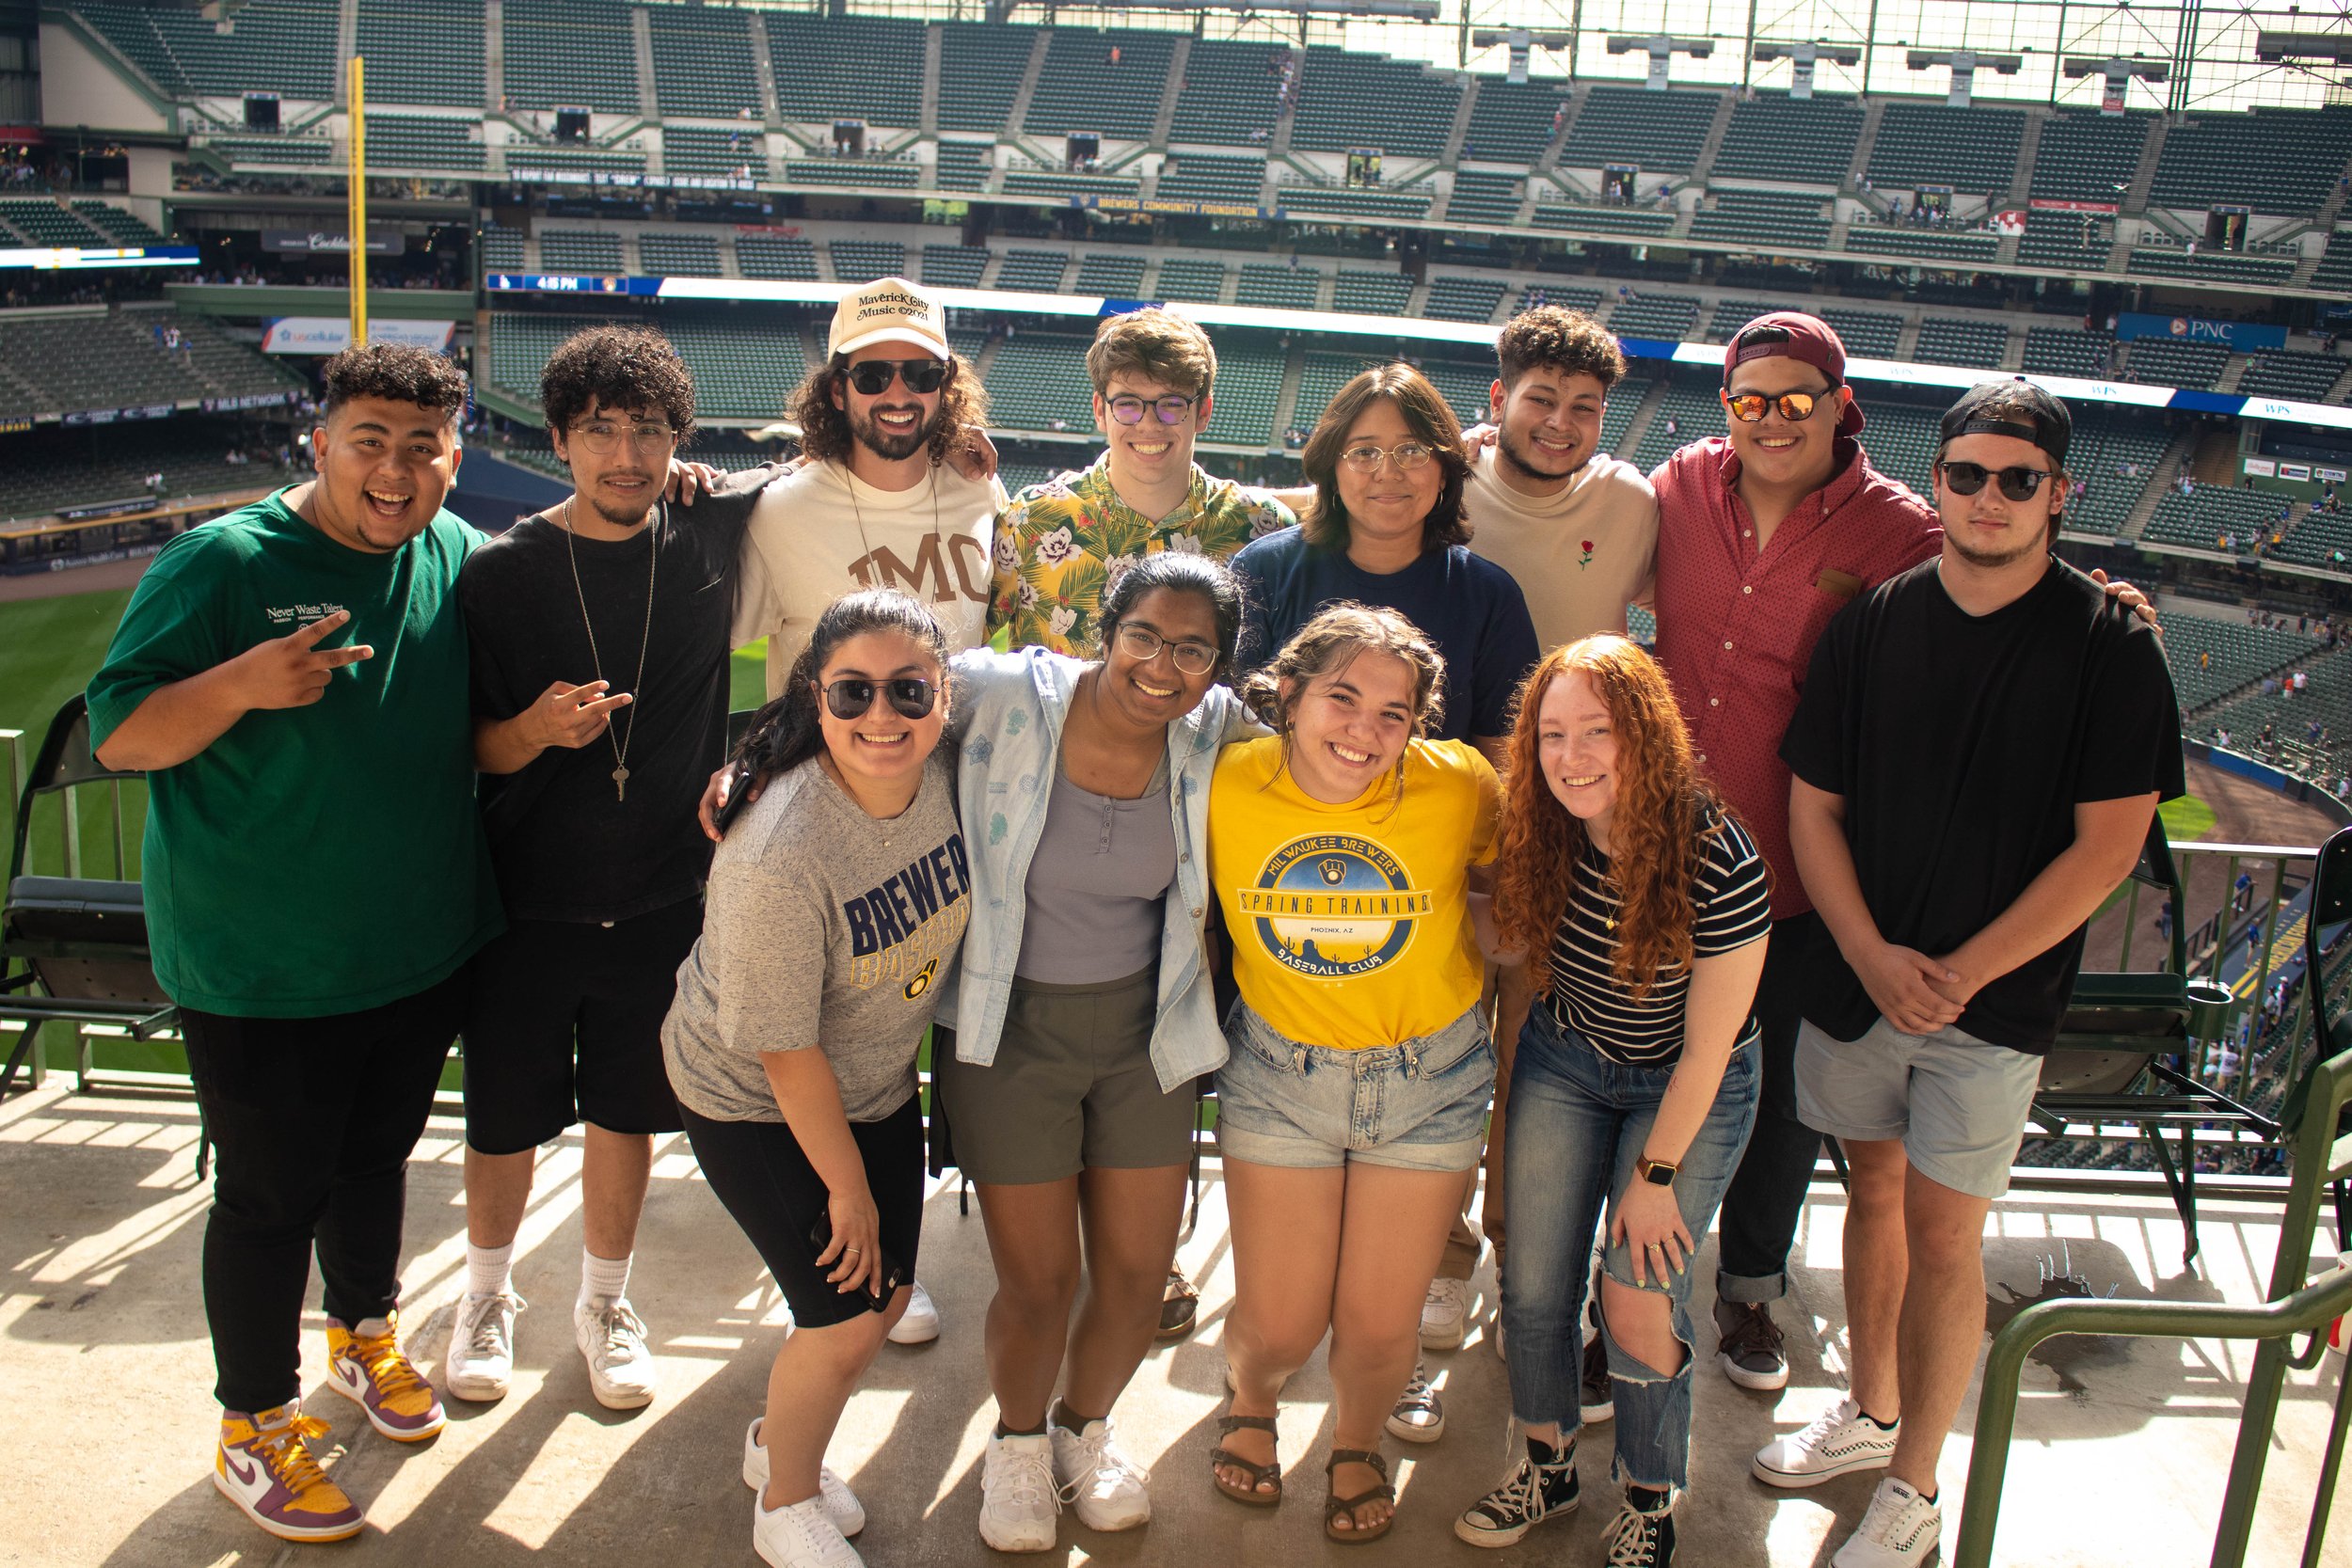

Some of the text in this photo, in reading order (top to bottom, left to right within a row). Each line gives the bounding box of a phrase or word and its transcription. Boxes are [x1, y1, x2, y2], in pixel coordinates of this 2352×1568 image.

[1098, 198, 1258, 216] BREWERS COMMUNITY FOUNDATION
[560, 277, 578, 291] PM
[858, 293, 930, 311] Maverick City
[857, 306, 896, 321] Music
[2191, 321, 2233, 339] PNC
[217, 392, 286, 411] MLB NETWORK
[2265, 404, 2291, 415] WPS
[265, 603, 343, 619] Never Waste Talent
[1267, 837, 1399, 877] MILWAUKEE BREWERS
[1240, 894, 1428, 914] SPRING TRAINING
[1278, 948, 1383, 975] BASEBALL CLUB
[1893, 1485, 1910, 1498] VANS
